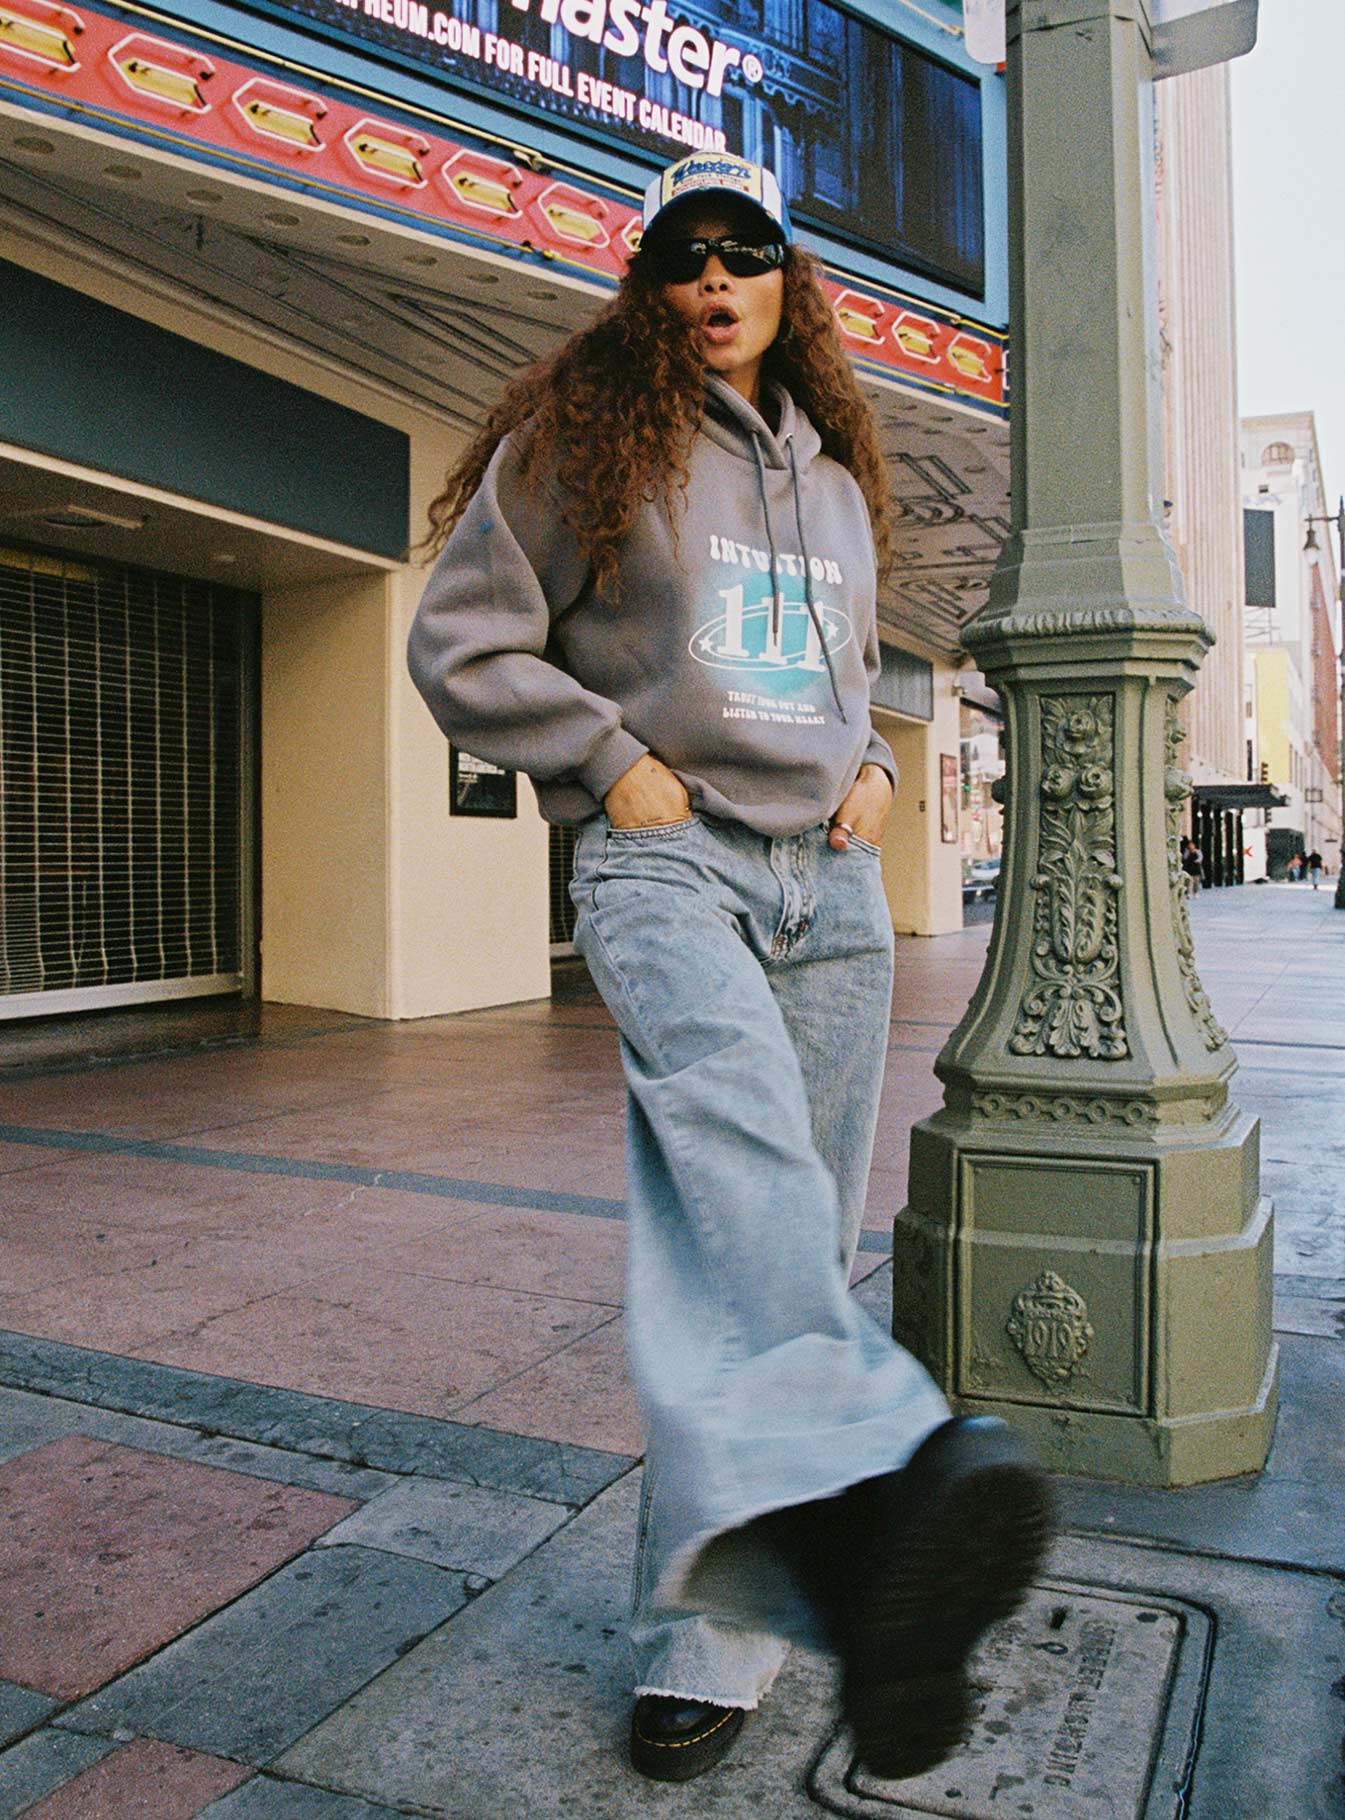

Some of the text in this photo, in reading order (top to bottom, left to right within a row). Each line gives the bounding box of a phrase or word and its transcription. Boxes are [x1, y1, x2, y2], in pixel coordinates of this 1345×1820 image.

[484, 33, 524, 77] FOR
[528, 50, 574, 97] FULL
[577, 72, 636, 121] EVENT
[639, 98, 726, 152] CALENDAR
